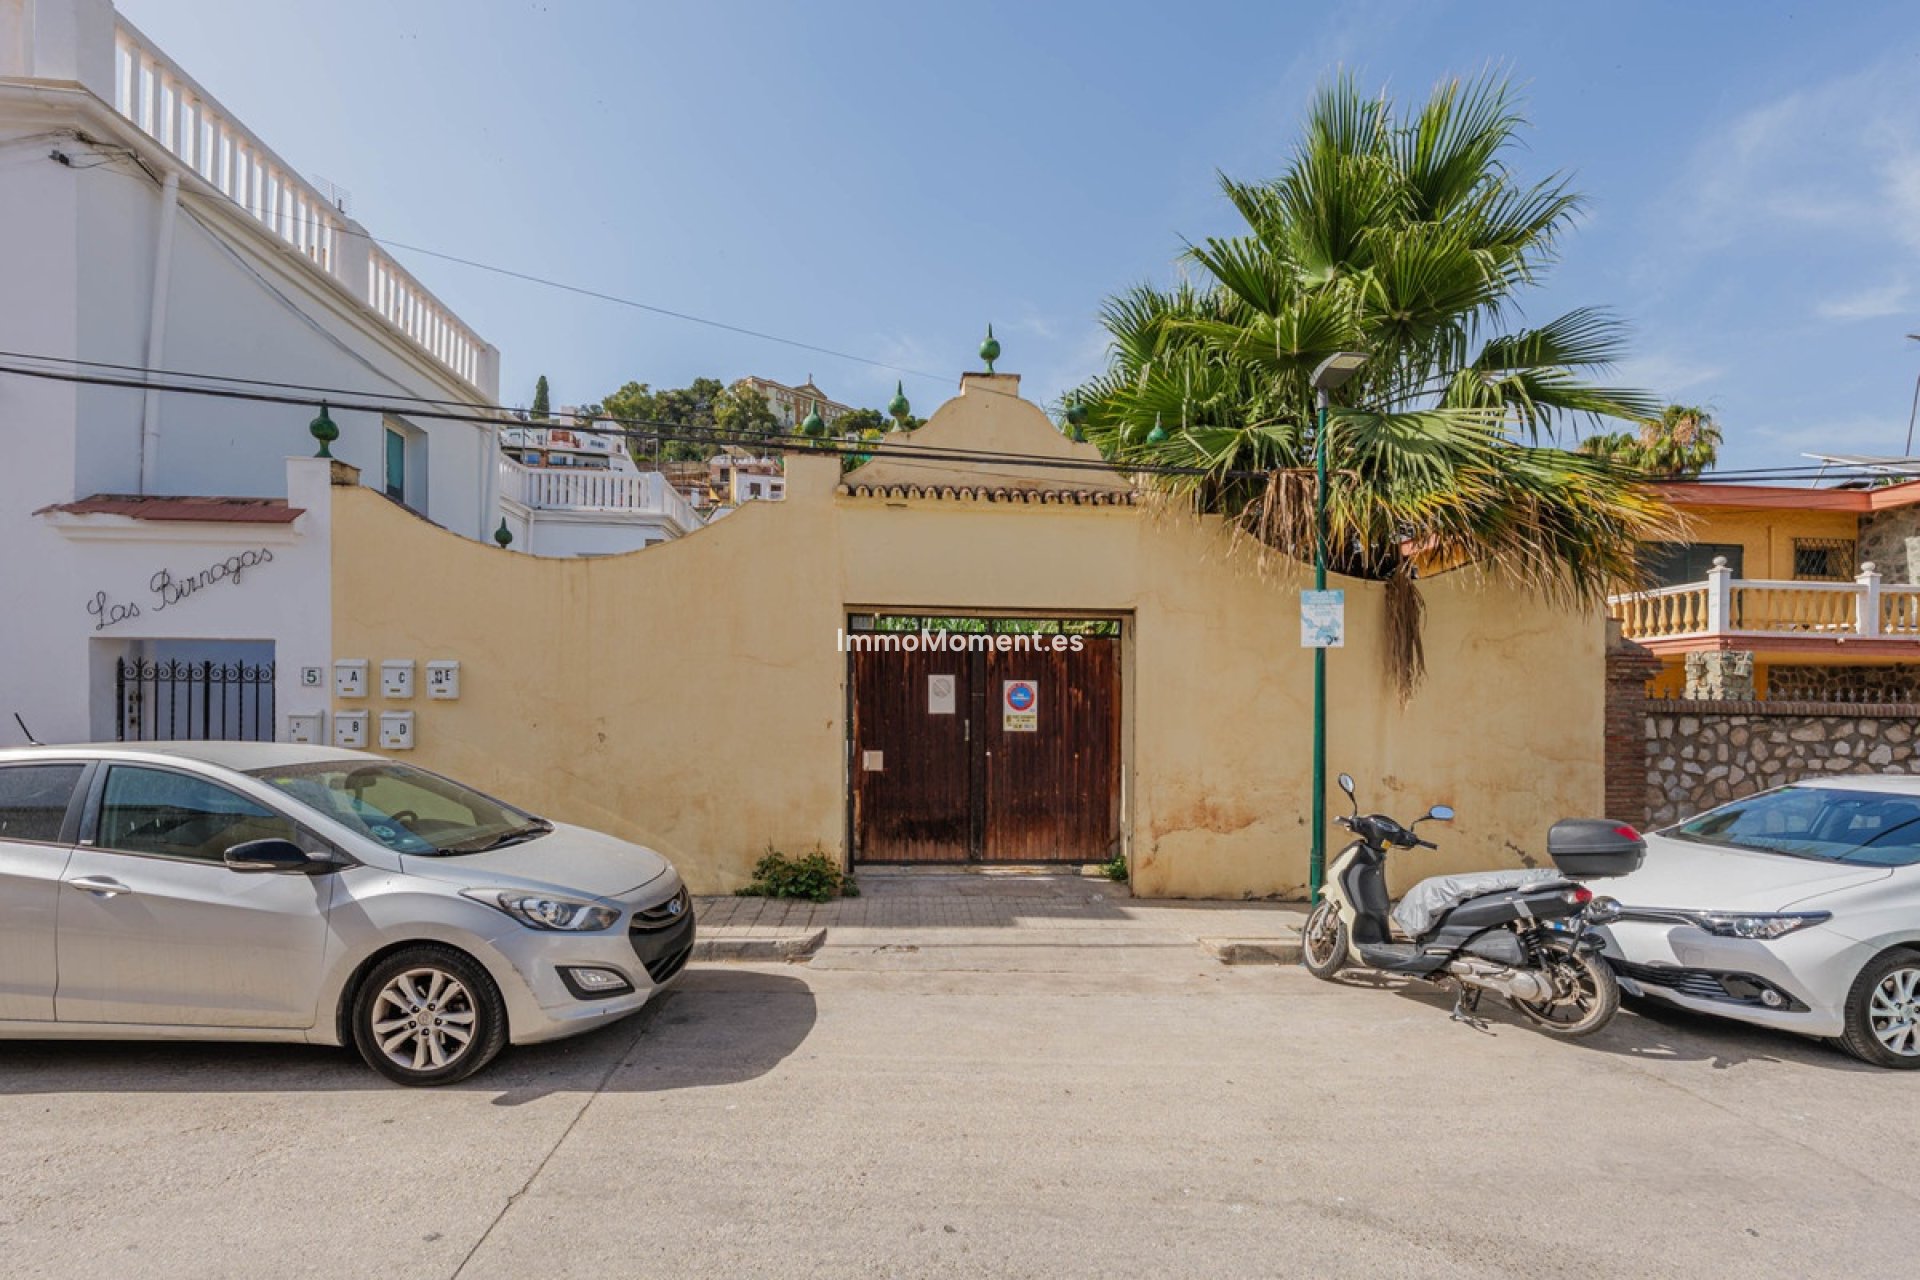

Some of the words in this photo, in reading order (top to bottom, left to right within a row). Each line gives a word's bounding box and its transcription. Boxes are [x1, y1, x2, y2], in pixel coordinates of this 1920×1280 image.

[87, 591, 141, 631] Las
[306, 669, 317, 684] 5
[350, 671, 358, 682] A
[352, 721, 359, 733] B
